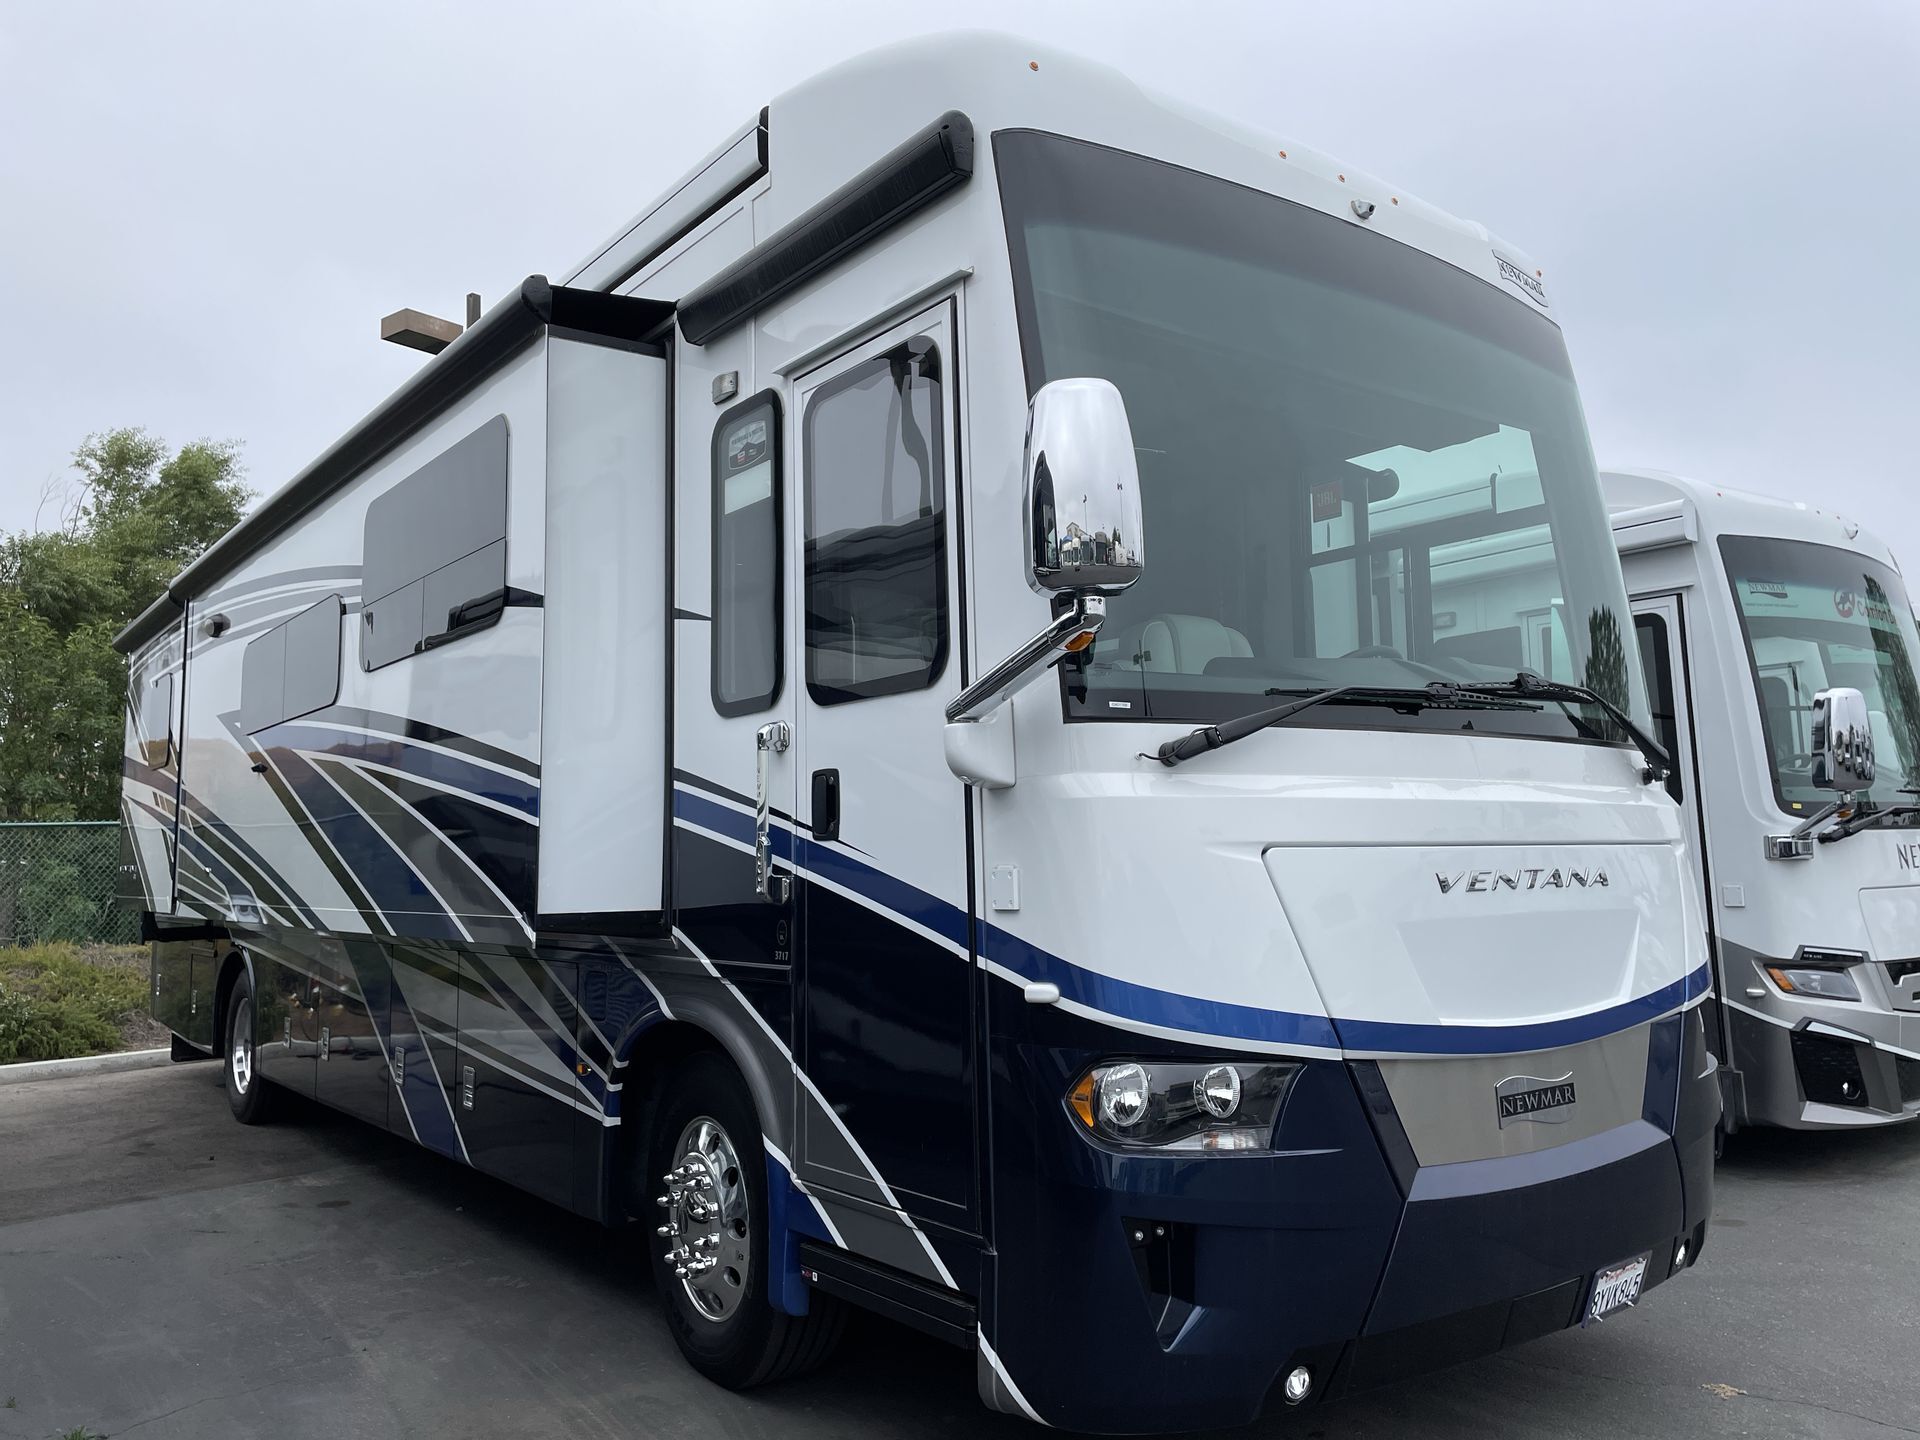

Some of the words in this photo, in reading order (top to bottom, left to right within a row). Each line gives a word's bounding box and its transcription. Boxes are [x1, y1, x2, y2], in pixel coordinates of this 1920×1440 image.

[1497, 260, 1546, 298] NEWMAR
[1896, 843, 1920, 870] NE
[1435, 866, 1609, 894] VENTANA
[1501, 1085, 1575, 1116] NEWMAR
[1590, 1272, 1642, 1315] 8YVK845
